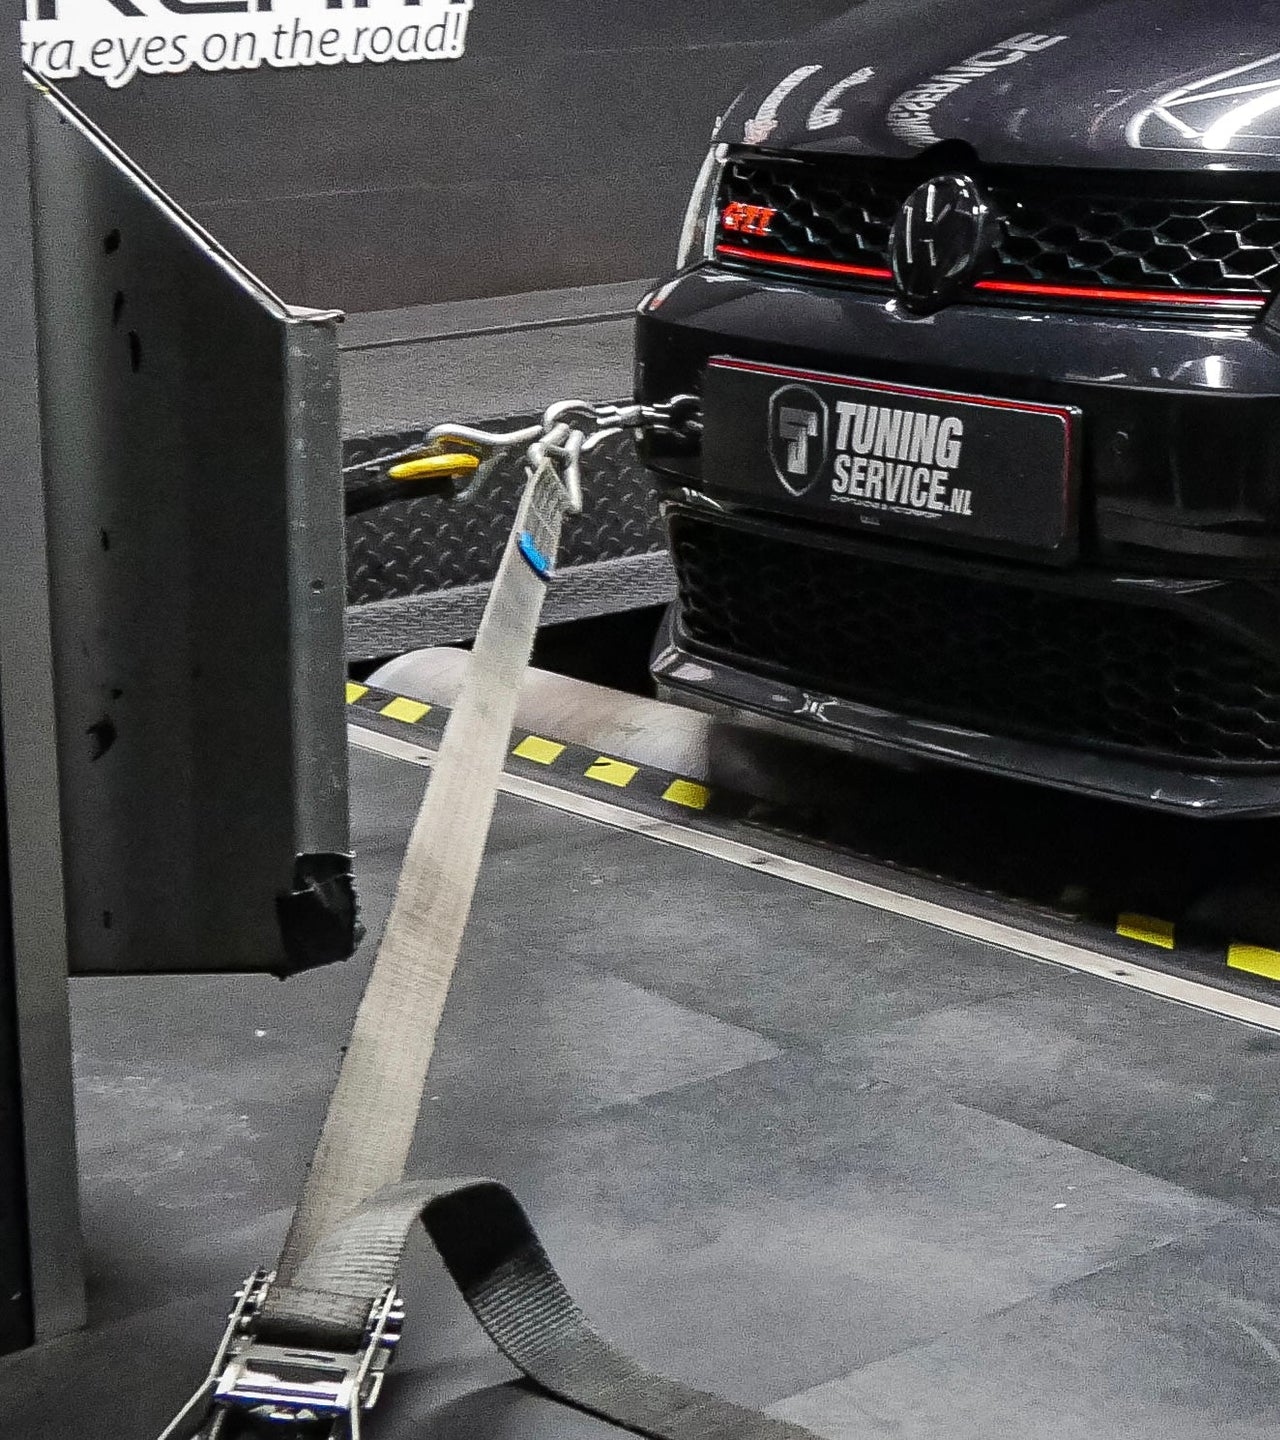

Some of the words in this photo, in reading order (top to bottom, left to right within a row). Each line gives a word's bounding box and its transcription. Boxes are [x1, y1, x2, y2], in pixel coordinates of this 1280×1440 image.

[91, 32, 186, 81] eyes
[202, 29, 257, 62] on
[272, 17, 342, 60] the
[352, 10, 463, 56] road!
[835, 400, 964, 469] TUNING
[831, 453, 973, 516] SERVICE.NL
